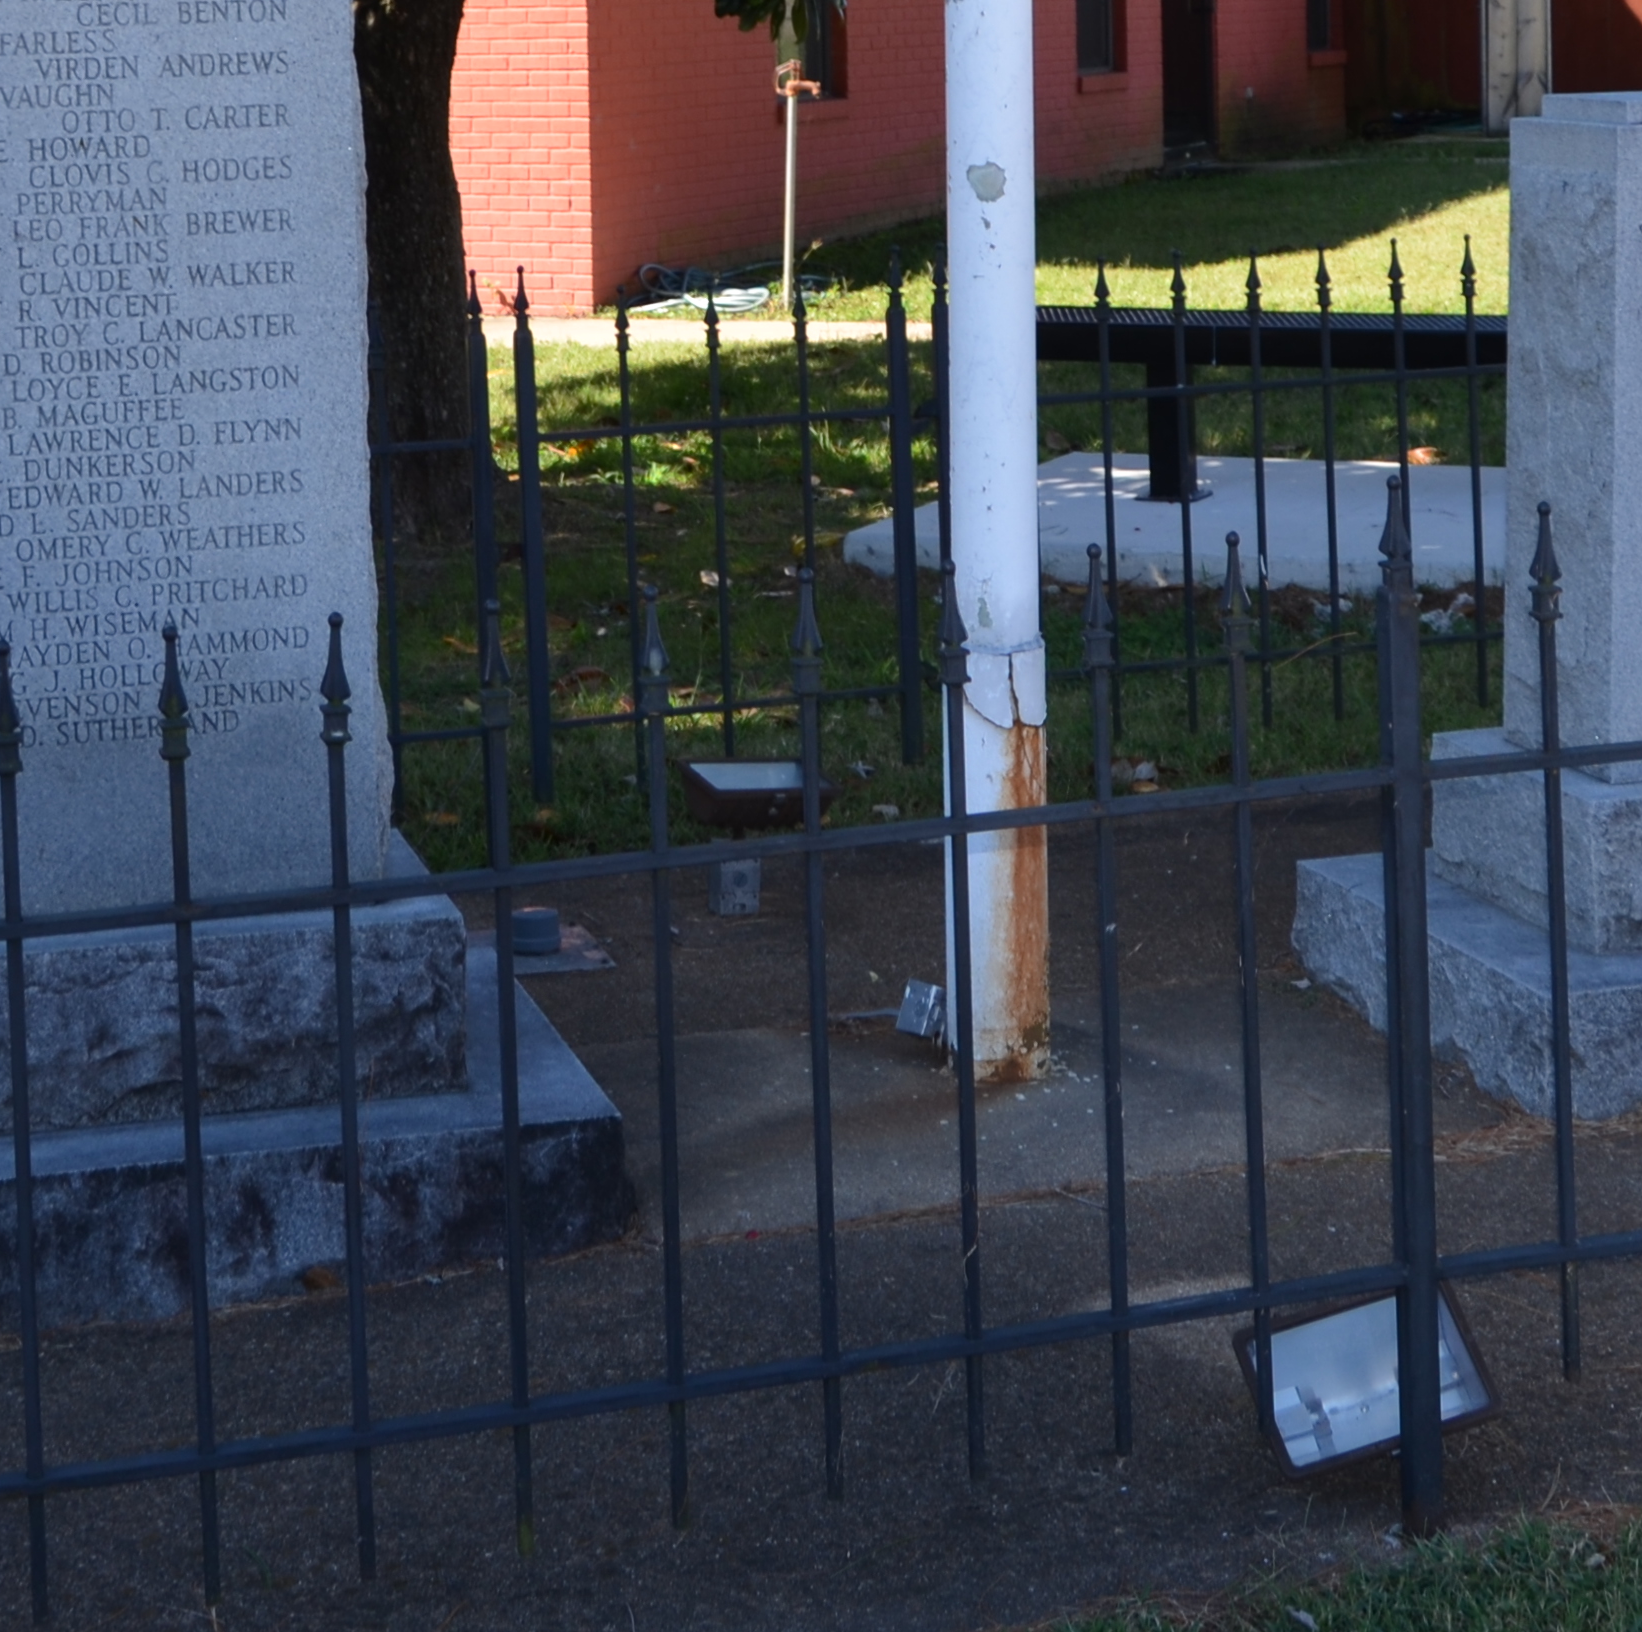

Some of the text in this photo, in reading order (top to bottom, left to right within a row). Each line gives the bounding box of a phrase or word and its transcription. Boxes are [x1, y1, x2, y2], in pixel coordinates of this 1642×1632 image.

[75, 0, 287, 27] CECIL BENTON
[0, 30, 117, 56] FARLESS
[35, 52, 290, 81] VIRDEN ANDREWS
[0, 85, 113, 110] VAUGHN
[61, 105, 292, 133] OTTO T. CARTER
[28, 136, 150, 162] HOWARD
[29, 162, 131, 188] CLOVIS
[181, 156, 292, 183] HODGES
[16, 188, 167, 217] PERRYMAN
[13, 209, 294, 242] LEO FRANK BREWER
[17, 247, 42, 269] L.
[52, 241, 170, 268] COLLINS
[19, 262, 297, 296] CLAUDE W. WALKER
[17, 299, 42, 322] R.
[54, 294, 176, 321] VINCENT
[15, 315, 298, 350] TROY C. LANCASTER
[3, 353, 27, 376] D.
[40, 347, 181, 374] ROBINSON
[12, 367, 300, 403] LOYCE E. LANGSTON
[2, 407, 24, 430] B.
[37, 399, 185, 428] MAGUFFEE
[7, 419, 302, 457] LAWRENCE D. FLYNN
[23, 450, 195, 482] DUNKERSON
[8, 470, 304, 509] EDWARD W. LANDERS
[30, 513, 56, 535] L.
[66, 504, 191, 533] SANDERS
[15, 522, 306, 562] OMERY C. WEATHERS
[22, 567, 42, 589] F.
[56, 556, 194, 587] JOHNSON
[7, 575, 308, 614] WILLIS C. PRITCHARD
[30, 618, 56, 641] H.
[65, 608, 200, 638] WISEMAN
[128, 638, 151, 660] O.
[44, 671, 66, 693] J.
[79, 659, 229, 691] HOLLOWAY
[195, 679, 313, 708] JENKINS
[16, 726, 43, 749] D.
[56, 711, 240, 746] SUTHERAND
